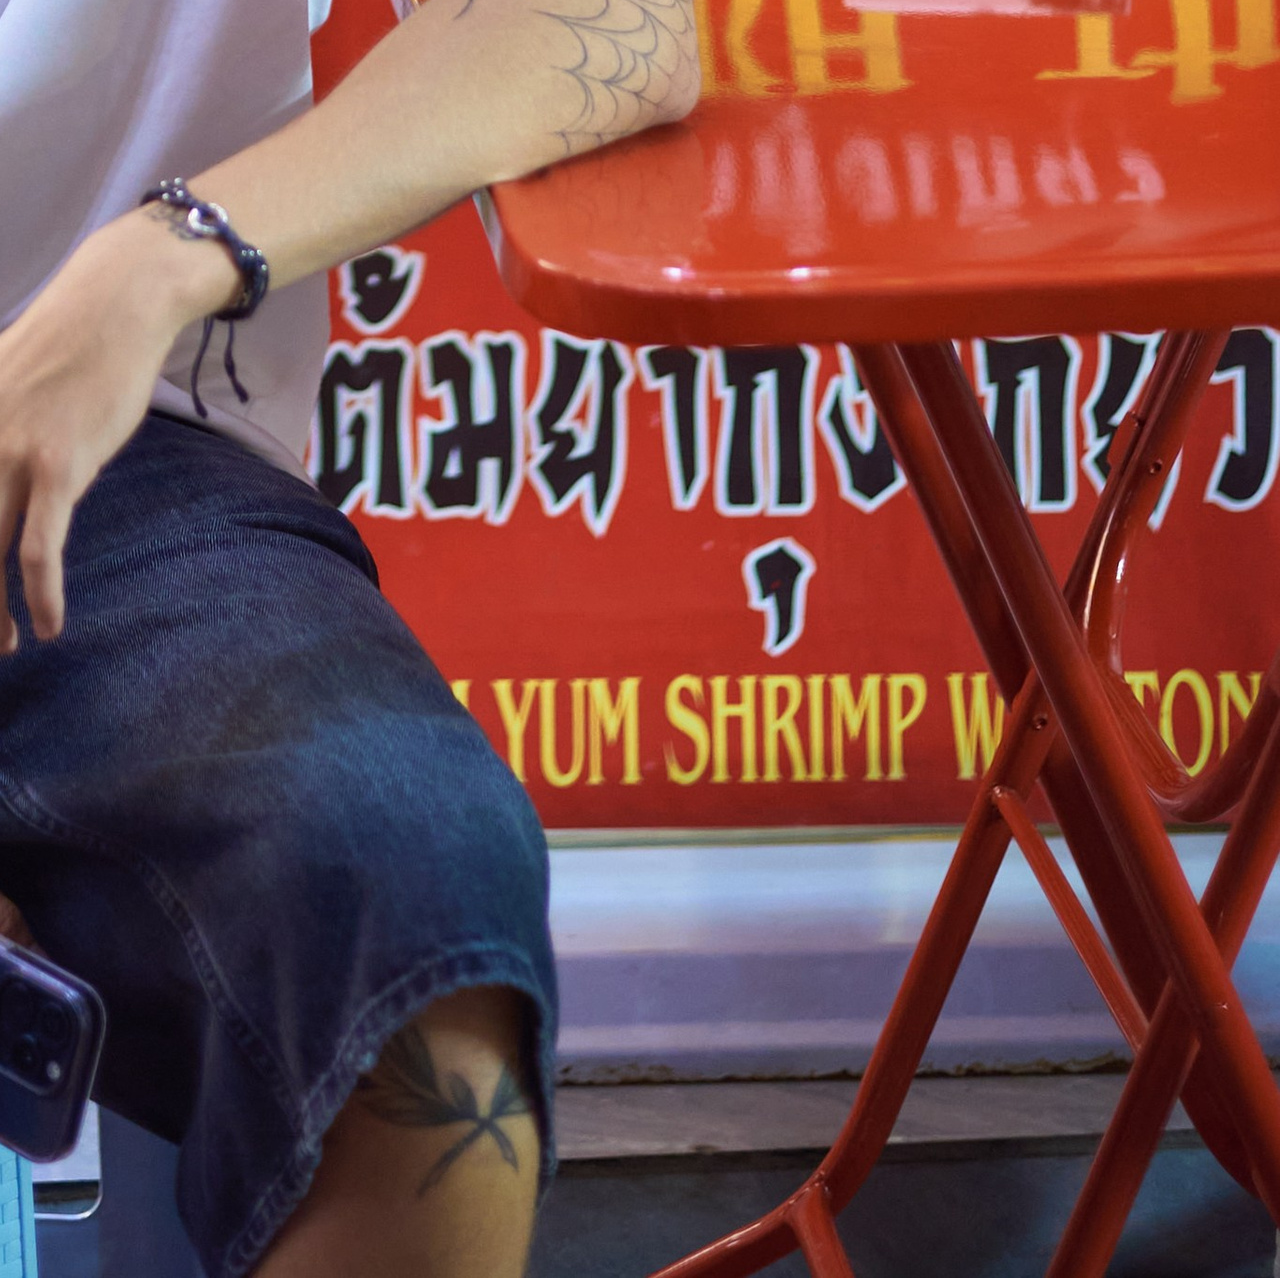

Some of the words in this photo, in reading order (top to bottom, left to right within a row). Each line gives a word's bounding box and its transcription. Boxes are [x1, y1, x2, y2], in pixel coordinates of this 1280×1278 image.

[489, 678, 642, 788] YUM
[664, 672, 928, 787] SHRIMP
[946, 669, 1265, 780] WTON
